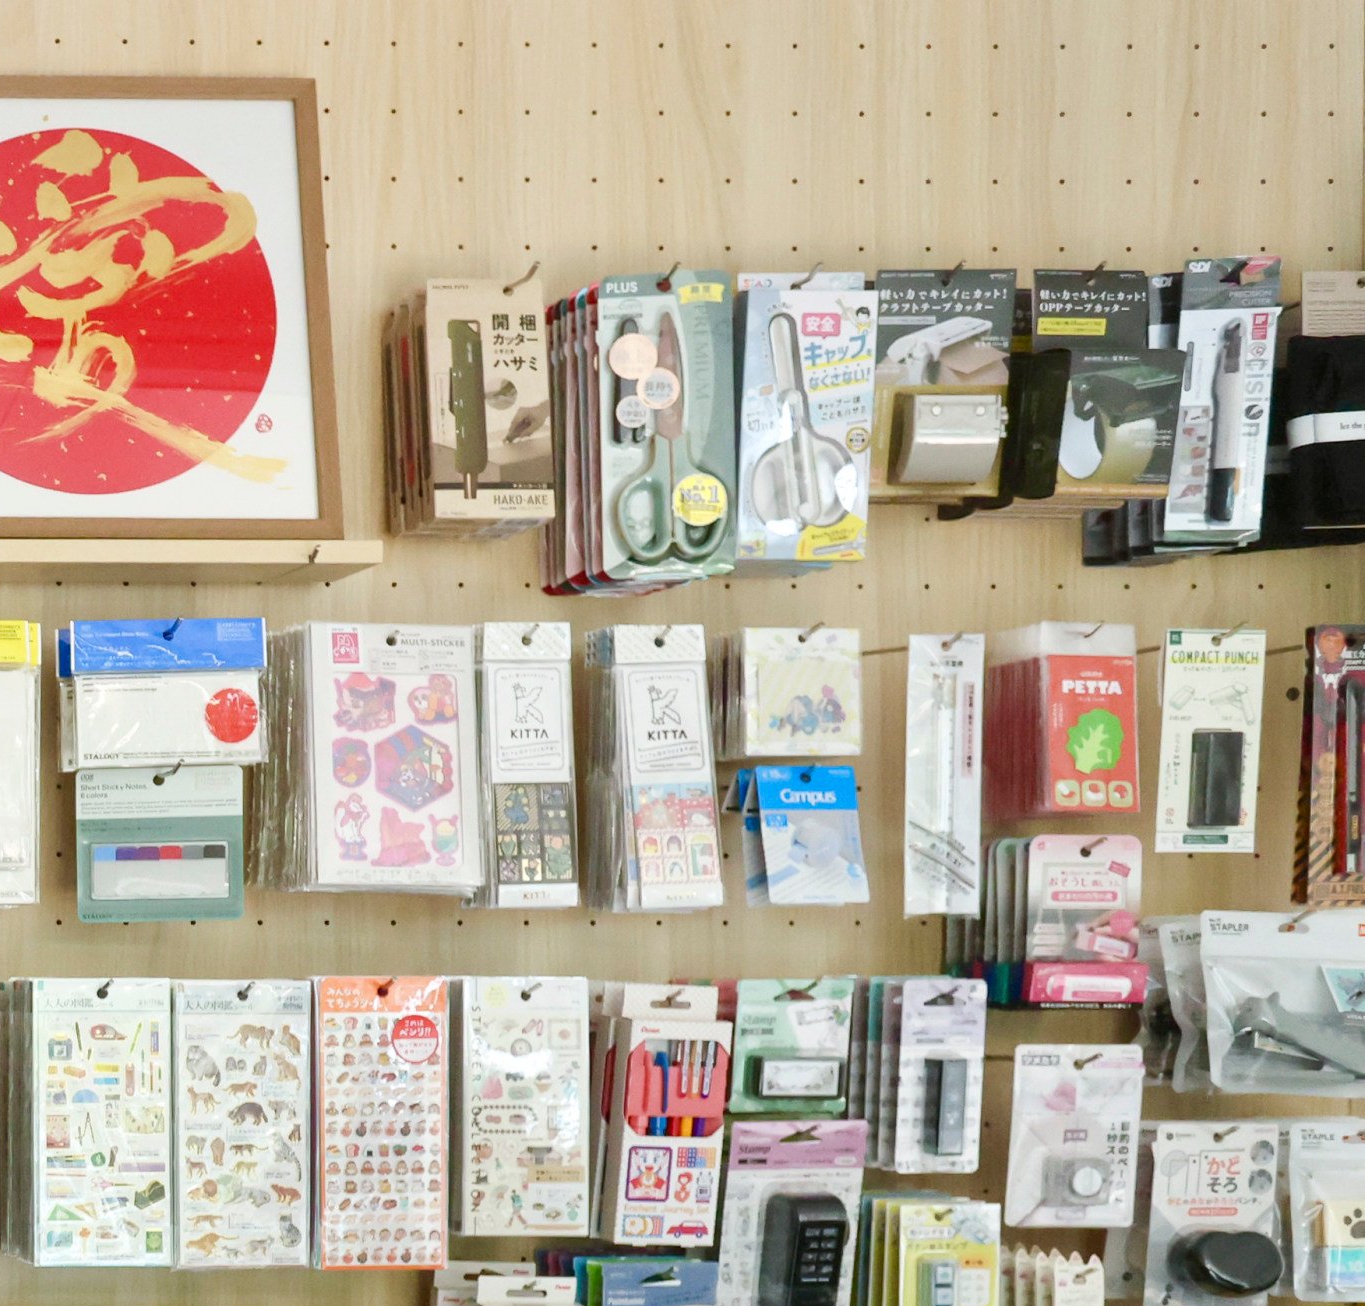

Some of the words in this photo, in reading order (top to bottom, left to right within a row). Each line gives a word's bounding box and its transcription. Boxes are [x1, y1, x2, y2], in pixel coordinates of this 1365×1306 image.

[1189, 262, 1211, 273] SDI
[606, 282, 638, 294] PLUS
[879, 288, 1007, 300] 軽い力でキレイにカット!
[880, 303, 994, 313] クラフトテープカッター
[1039, 303, 1130, 313] OPPテープカッター
[492, 314, 537, 331] 開梱
[493, 334, 539, 347] カッター
[493, 356, 539, 371] ハサミ
[400, 638, 465, 648] MULTI-STICKER
[1171, 651, 1220, 664] COMPACT
[1224, 651, 1259, 664] PUNCH
[1061, 679, 1122, 696] PETTA
[510, 728, 549, 741] KITTA
[647, 729, 688, 742] KITTA
[779, 788, 837, 805] Campus
[1210, 923, 1249, 932] STAPLER
[326, 987, 361, 997] みんなの
[1301, 1132, 1335, 1141] STAPLE
[1207, 1157, 1241, 1175] かど
[1207, 1177, 1238, 1193] そろ
